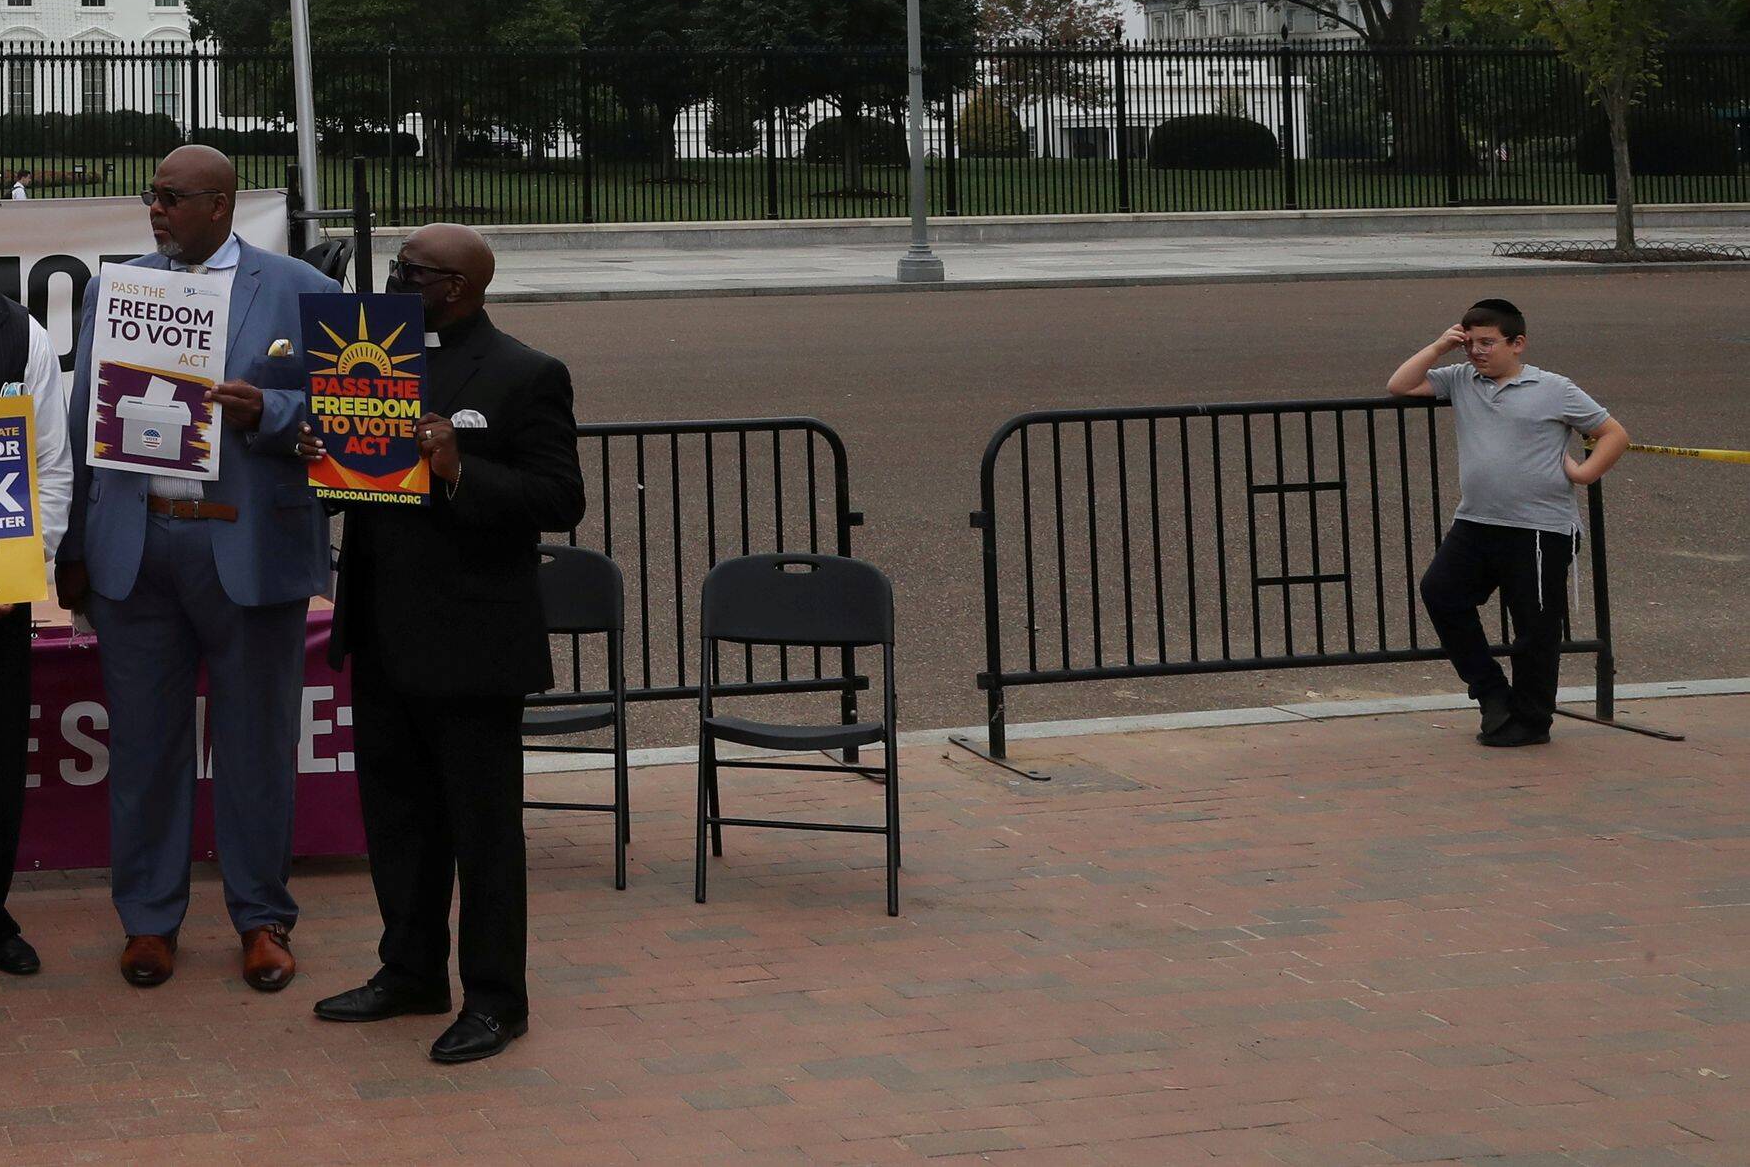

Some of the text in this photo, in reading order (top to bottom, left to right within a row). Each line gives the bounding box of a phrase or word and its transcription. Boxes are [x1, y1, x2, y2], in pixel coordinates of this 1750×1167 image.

[111, 281, 166, 298] PASS THE
[108, 297, 214, 327] FREEDOM
[108, 318, 212, 351] TO VOTE
[178, 353, 209, 368] ACT
[311, 377, 419, 399] PASS THE
[311, 395, 421, 419] FREEDOM
[319, 415, 414, 438] TO VOTE
[344, 435, 390, 456] ACT
[316, 489, 421, 505] DFADCOALITION.ORG
